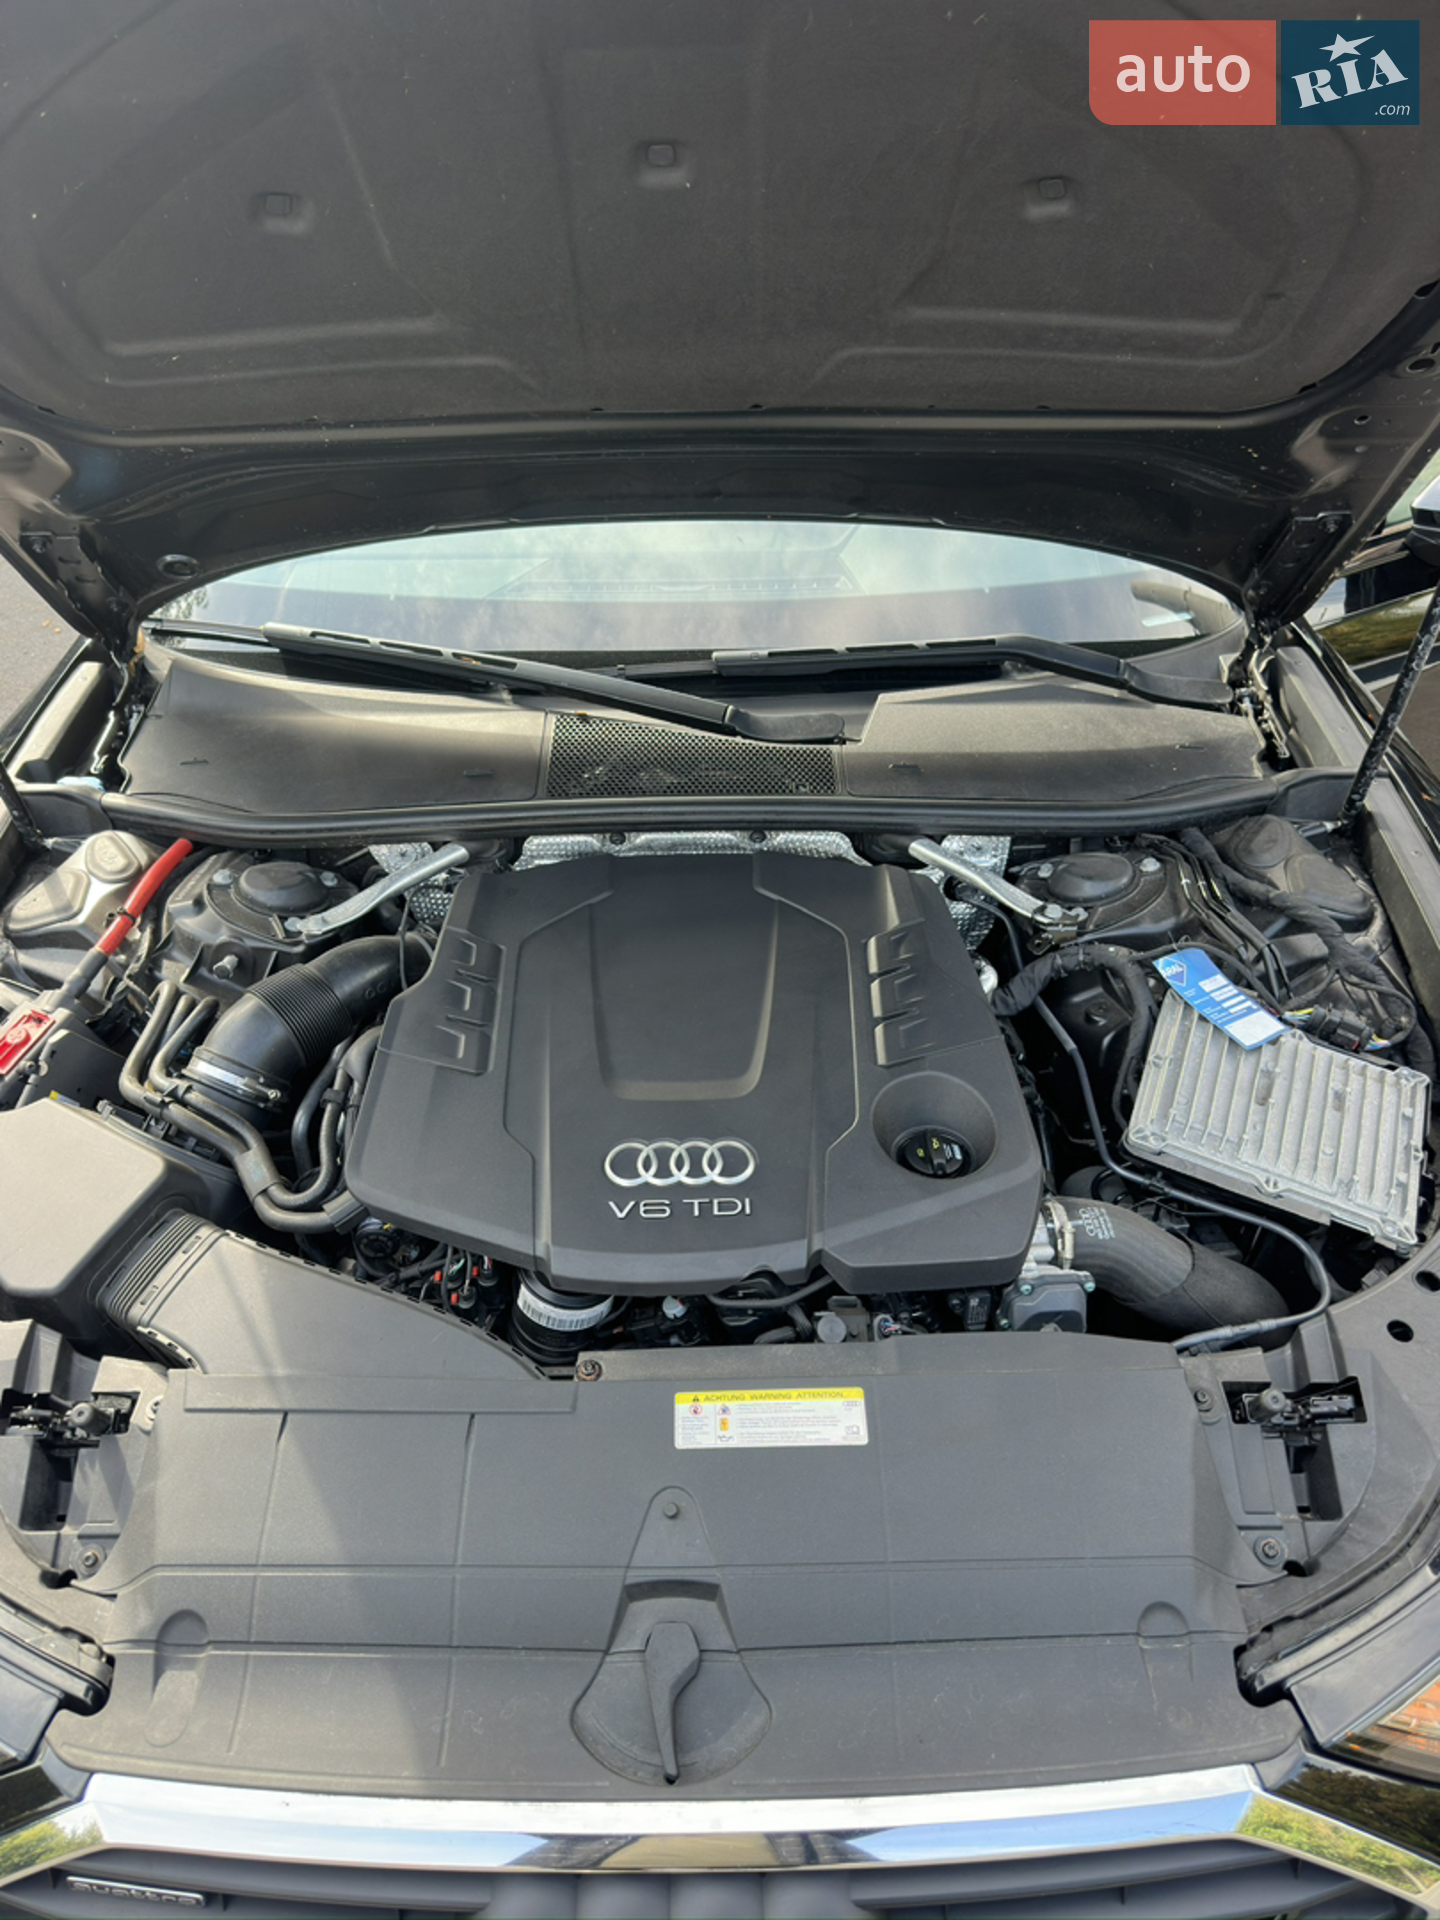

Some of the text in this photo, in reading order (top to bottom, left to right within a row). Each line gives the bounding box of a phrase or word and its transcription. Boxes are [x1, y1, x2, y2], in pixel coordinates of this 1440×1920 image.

[608, 1197, 751, 1219] V6 TDI
[703, 1391, 844, 1402] ACHTUNG WARNING ATTENTION
[72, 1881, 197, 1906] quattro
